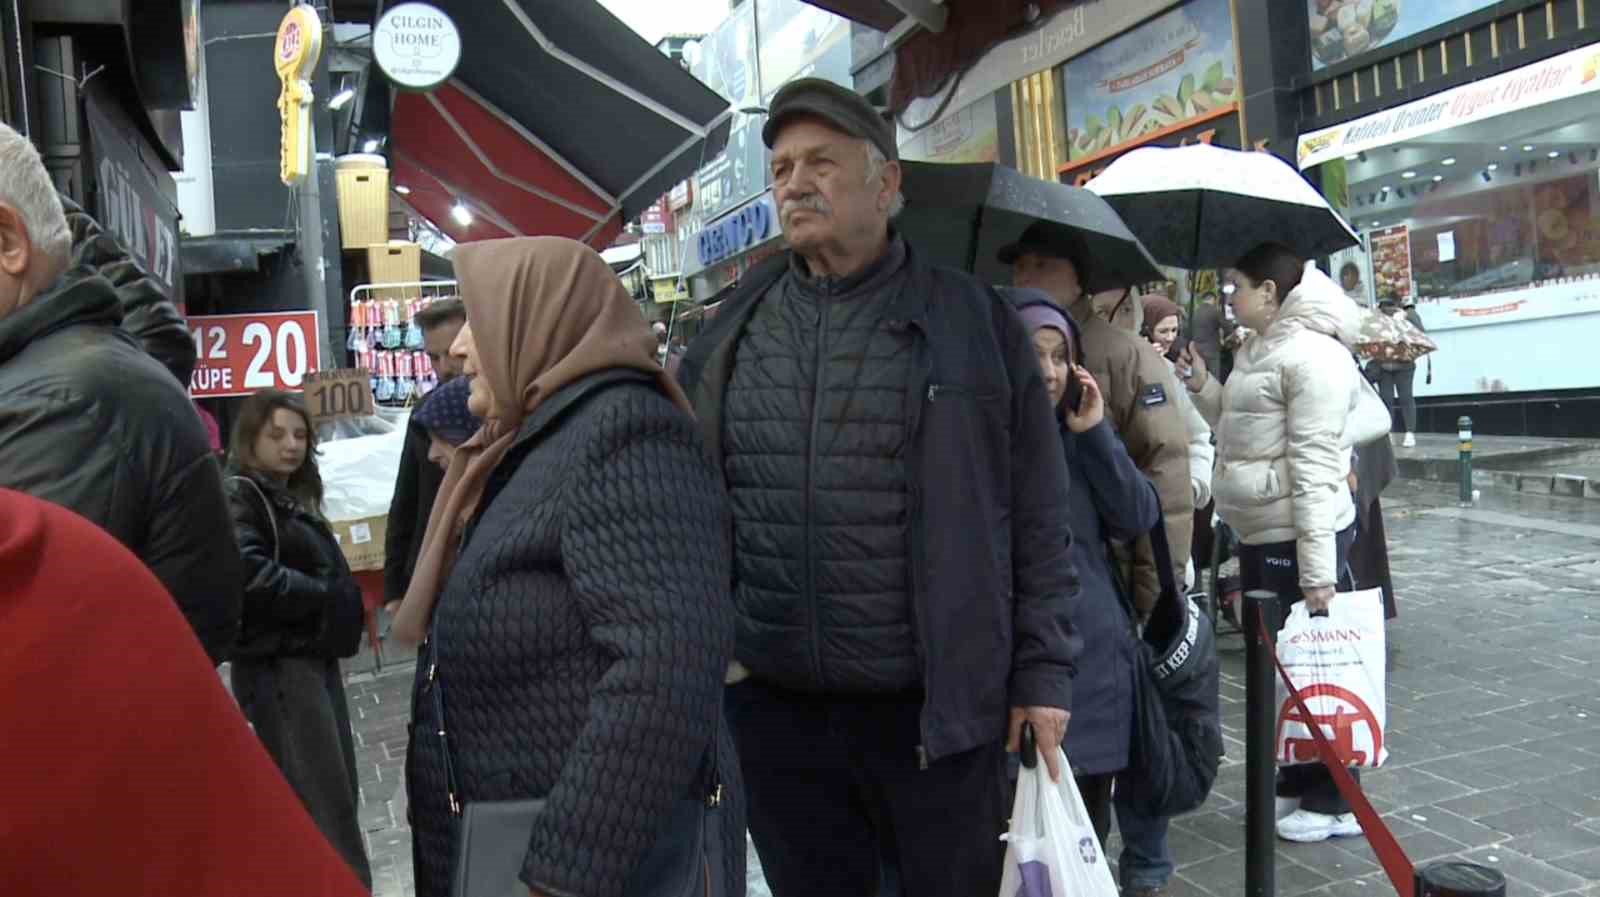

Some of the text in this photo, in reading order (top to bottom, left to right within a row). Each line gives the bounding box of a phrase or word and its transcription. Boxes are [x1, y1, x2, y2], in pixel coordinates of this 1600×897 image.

[394, 33, 441, 47] HOME
[192, 320, 307, 388] 12 20
[313, 381, 364, 416] 100
[1166, 640, 1191, 671] KEEP
